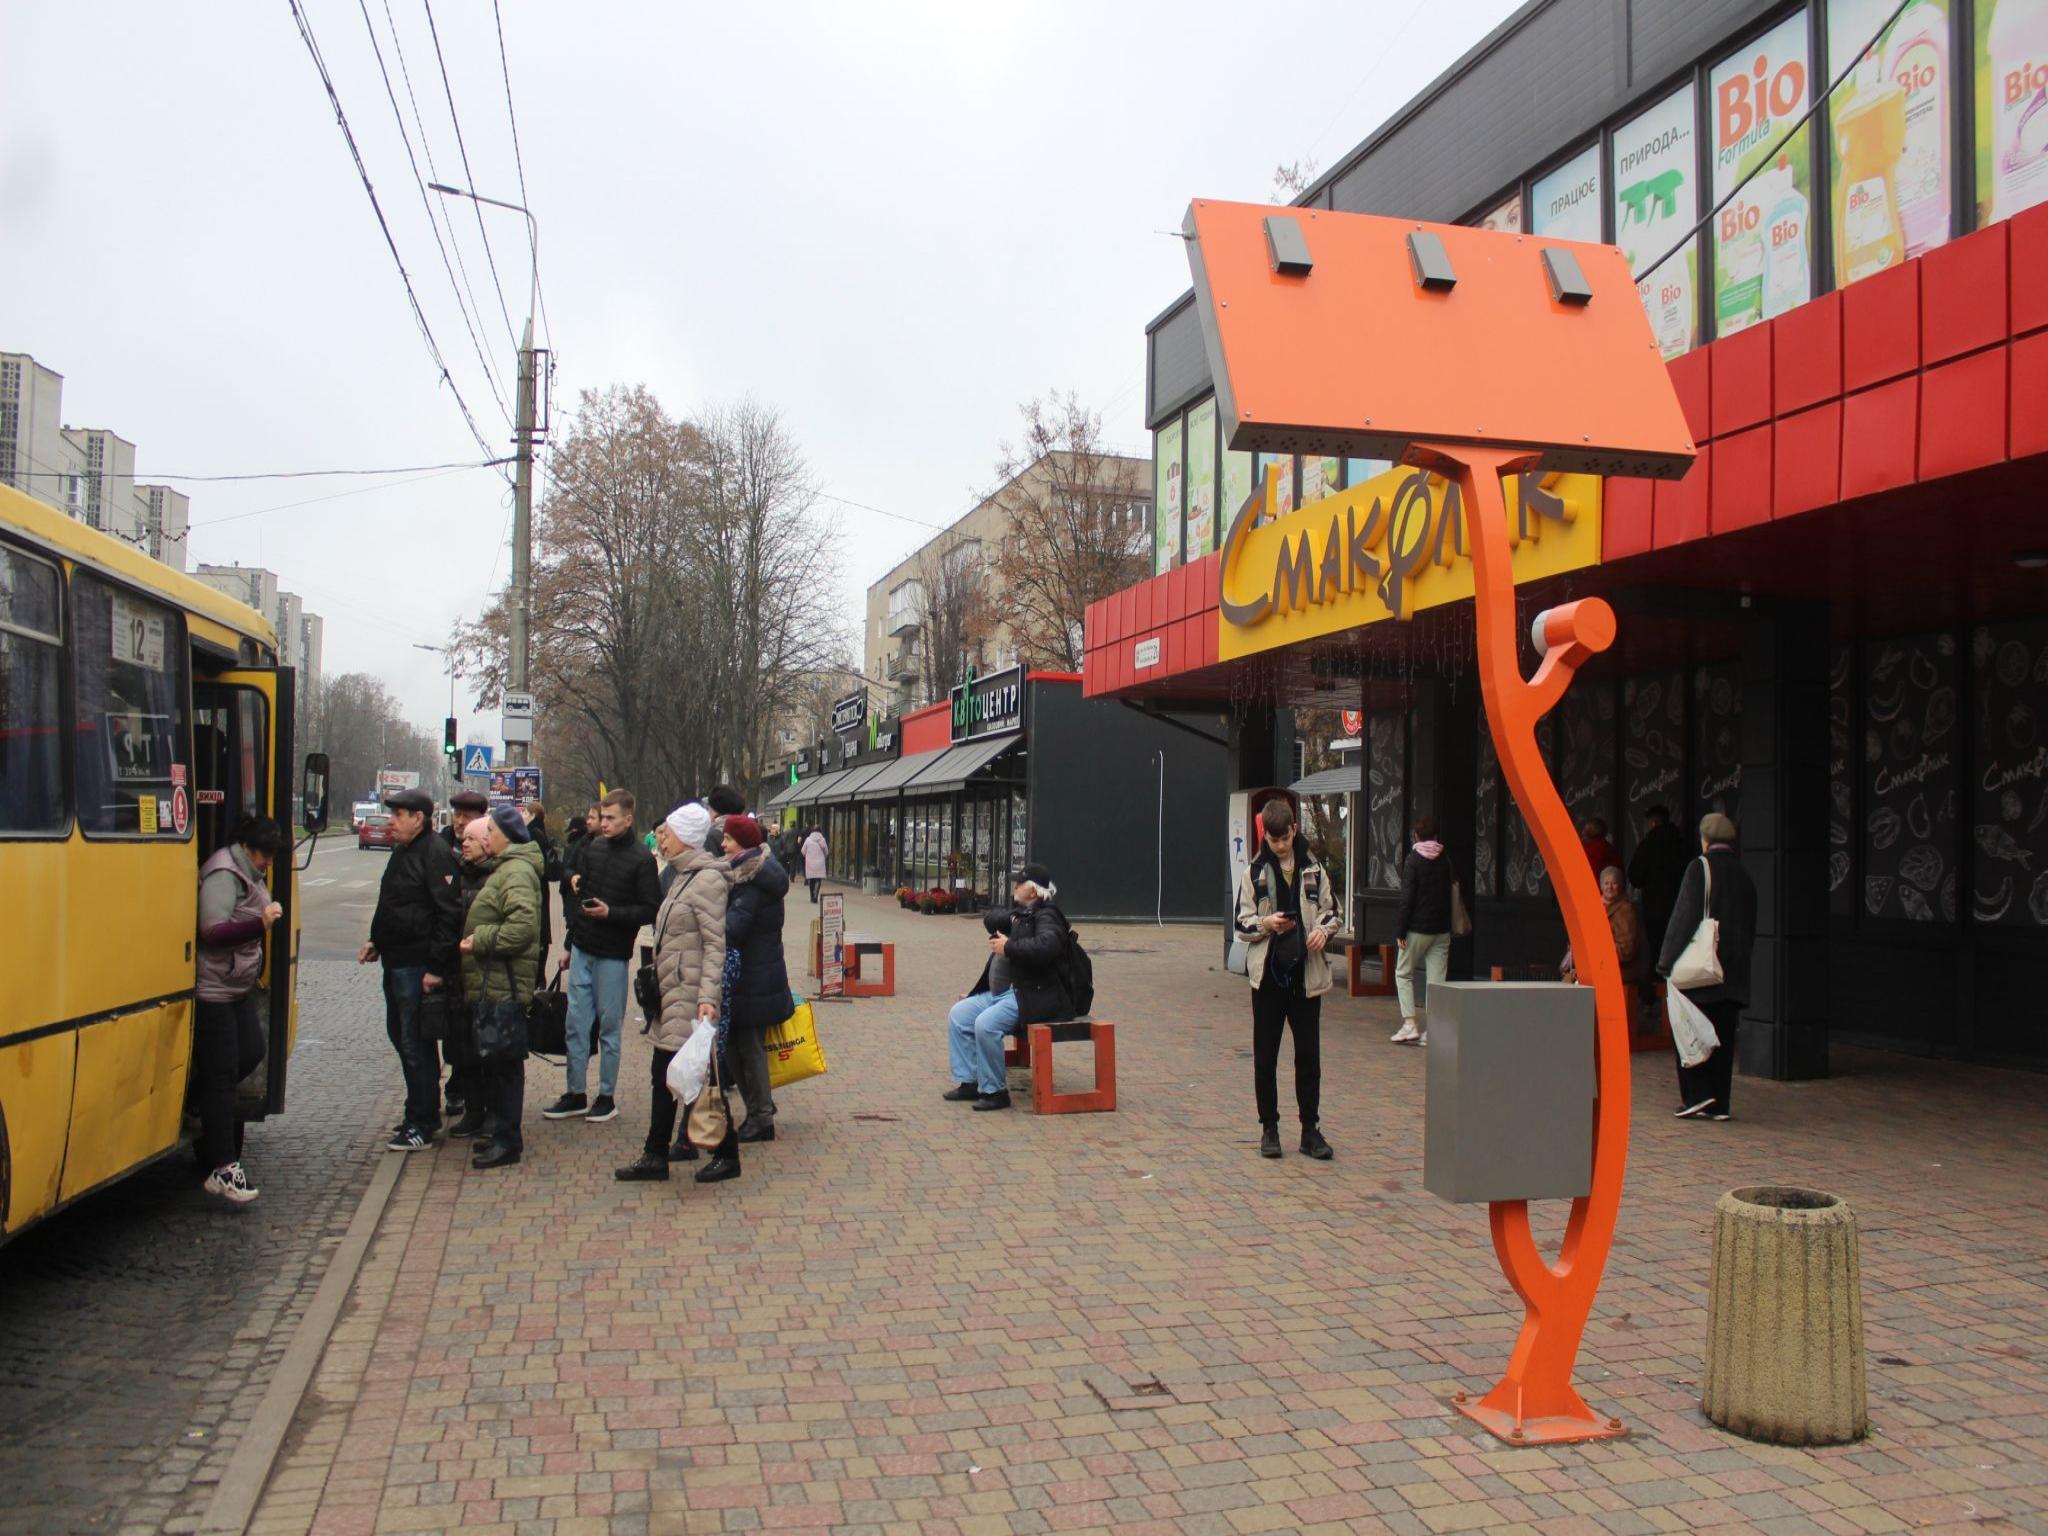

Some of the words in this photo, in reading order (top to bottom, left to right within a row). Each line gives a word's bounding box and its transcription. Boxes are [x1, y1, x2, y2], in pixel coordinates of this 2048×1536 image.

[1717, 54, 1805, 149] Bio
[2004, 62, 2048, 106] Bio
[1620, 126, 1691, 175] ПРИРОДА...
[1718, 117, 1771, 170] Formula
[1551, 177, 1597, 217] ПРАЦЮЄ
[1720, 200, 1760, 243] Bio
[1772, 219, 1799, 249] Bio
[1661, 284, 1682, 305] Bio
[130, 618, 145, 662] 12
[954, 684, 1017, 729] КВІТОЦЕНТР
